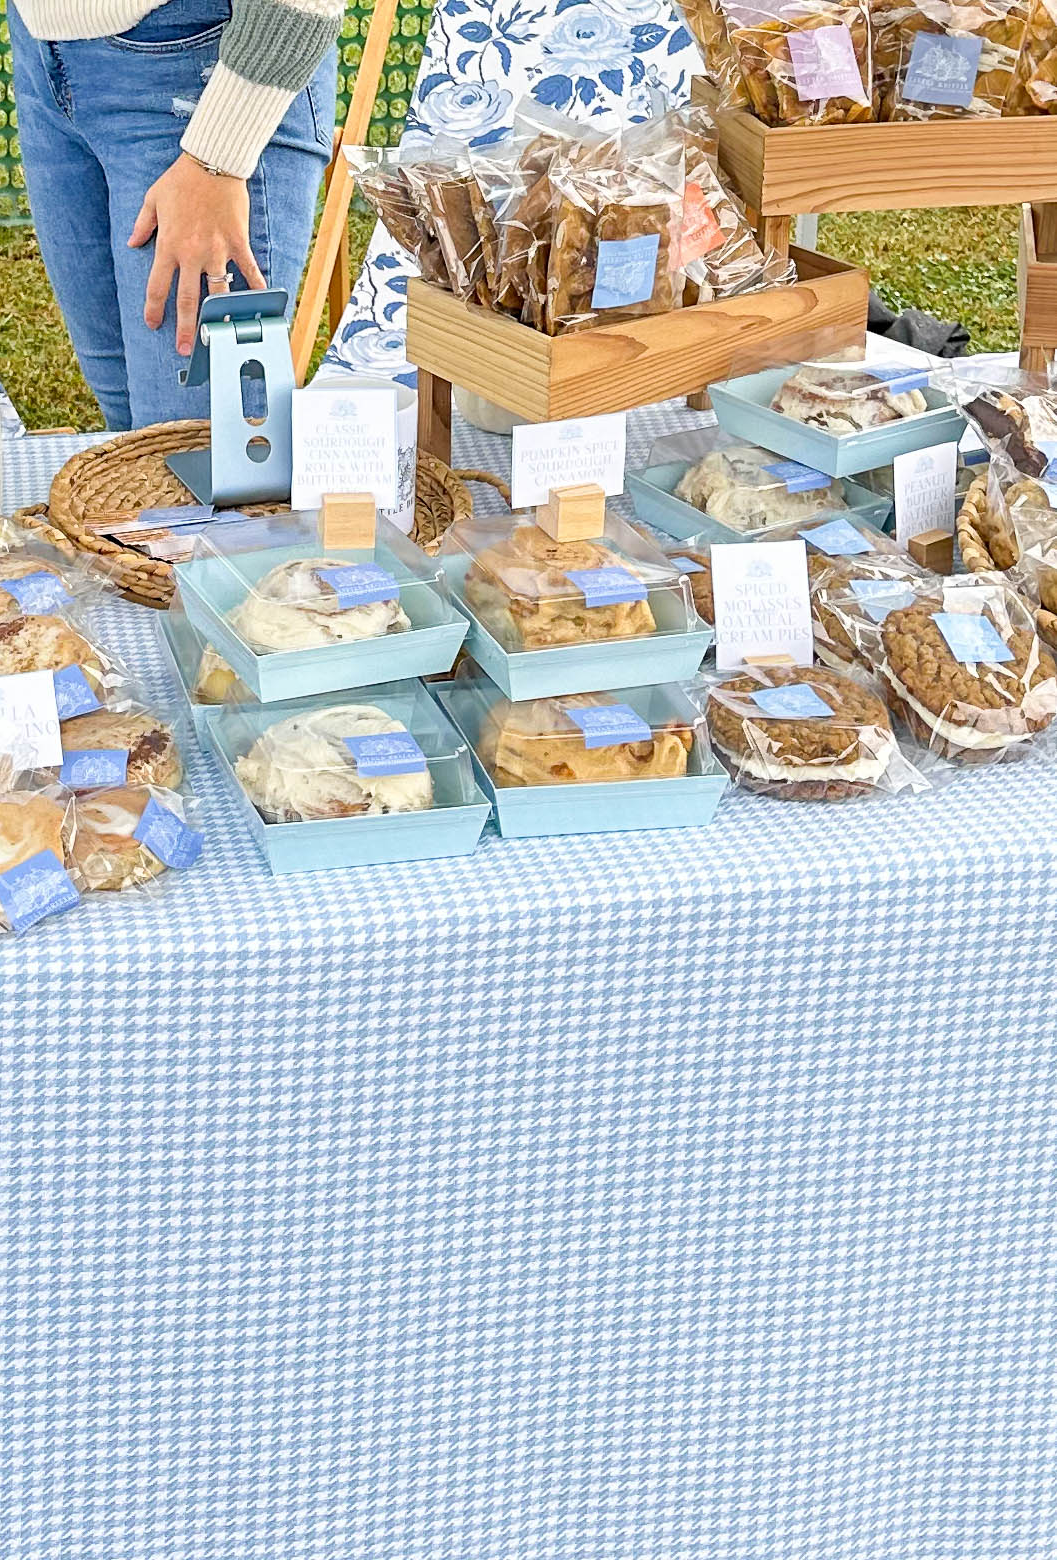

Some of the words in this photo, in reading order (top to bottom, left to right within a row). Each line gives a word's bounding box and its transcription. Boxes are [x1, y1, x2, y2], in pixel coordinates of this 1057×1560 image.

[314, 423, 370, 435] CLASSIC
[302, 436, 388, 449] SOURDOUGH
[308, 448, 381, 460] CINNAMON
[520, 444, 580, 463] PUMPKIN
[583, 440, 620, 454] SPICE
[303, 461, 346, 473] ROLLS
[349, 461, 385, 473] WITH
[527, 453, 615, 474] SOURDOUGH
[296, 473, 392, 486] BUTTERCREAM
[533, 467, 606, 487] CINNAMON
[903, 472, 948, 494] PEANUT
[906, 486, 948, 506] BUTTER
[734, 583, 788, 597] SPICED
[724, 597, 803, 613] MOLASSES
[721, 613, 796, 629] OATMEAL
[719, 630, 773, 644] CREAM
[777, 627, 810, 641] PIES
